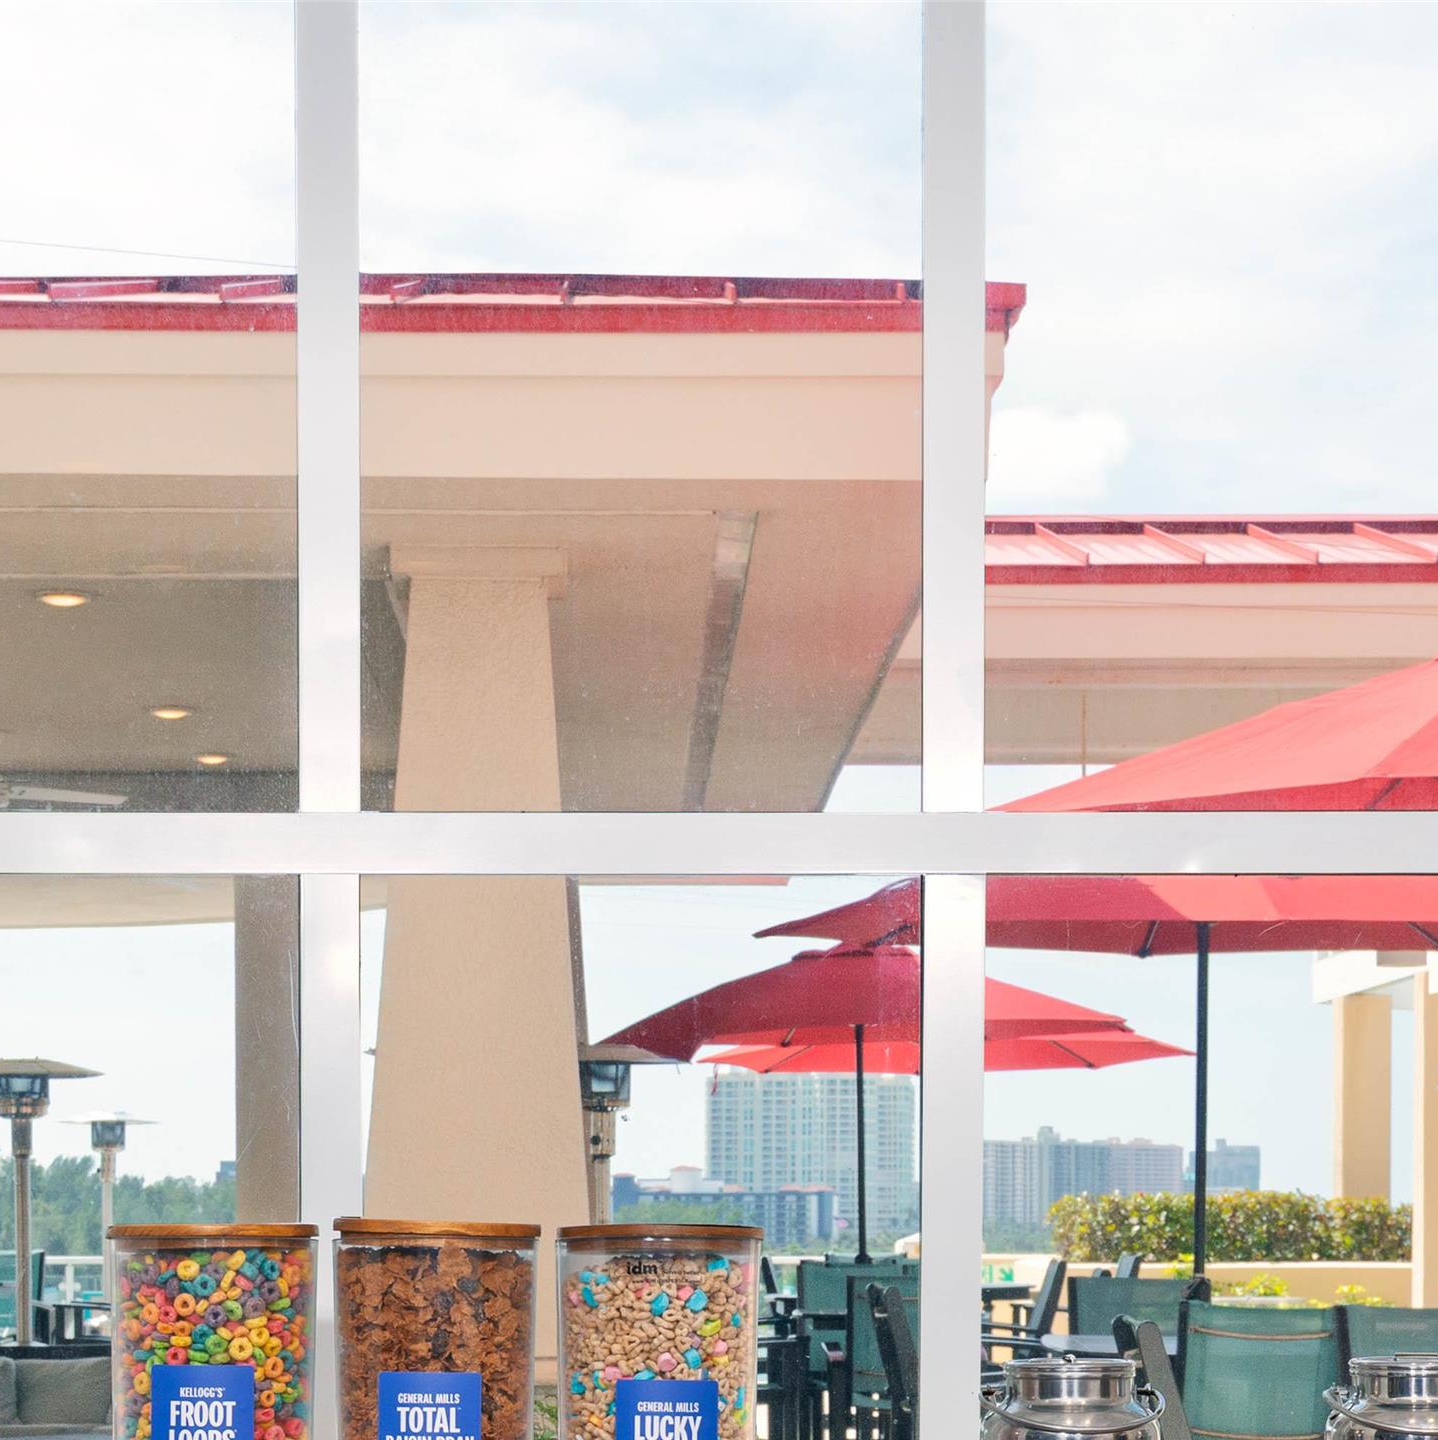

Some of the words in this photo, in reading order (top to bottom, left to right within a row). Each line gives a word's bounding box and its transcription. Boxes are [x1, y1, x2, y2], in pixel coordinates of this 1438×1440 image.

[626, 1261, 658, 1275] idm
[397, 1393, 433, 1404] GENERAL
[435, 1393, 460, 1404] MILLS
[169, 1400, 236, 1427] FROOT
[637, 1401, 673, 1412] GENERAL
[675, 1402, 699, 1413] MILLS
[396, 1406, 461, 1433] TOTAL
